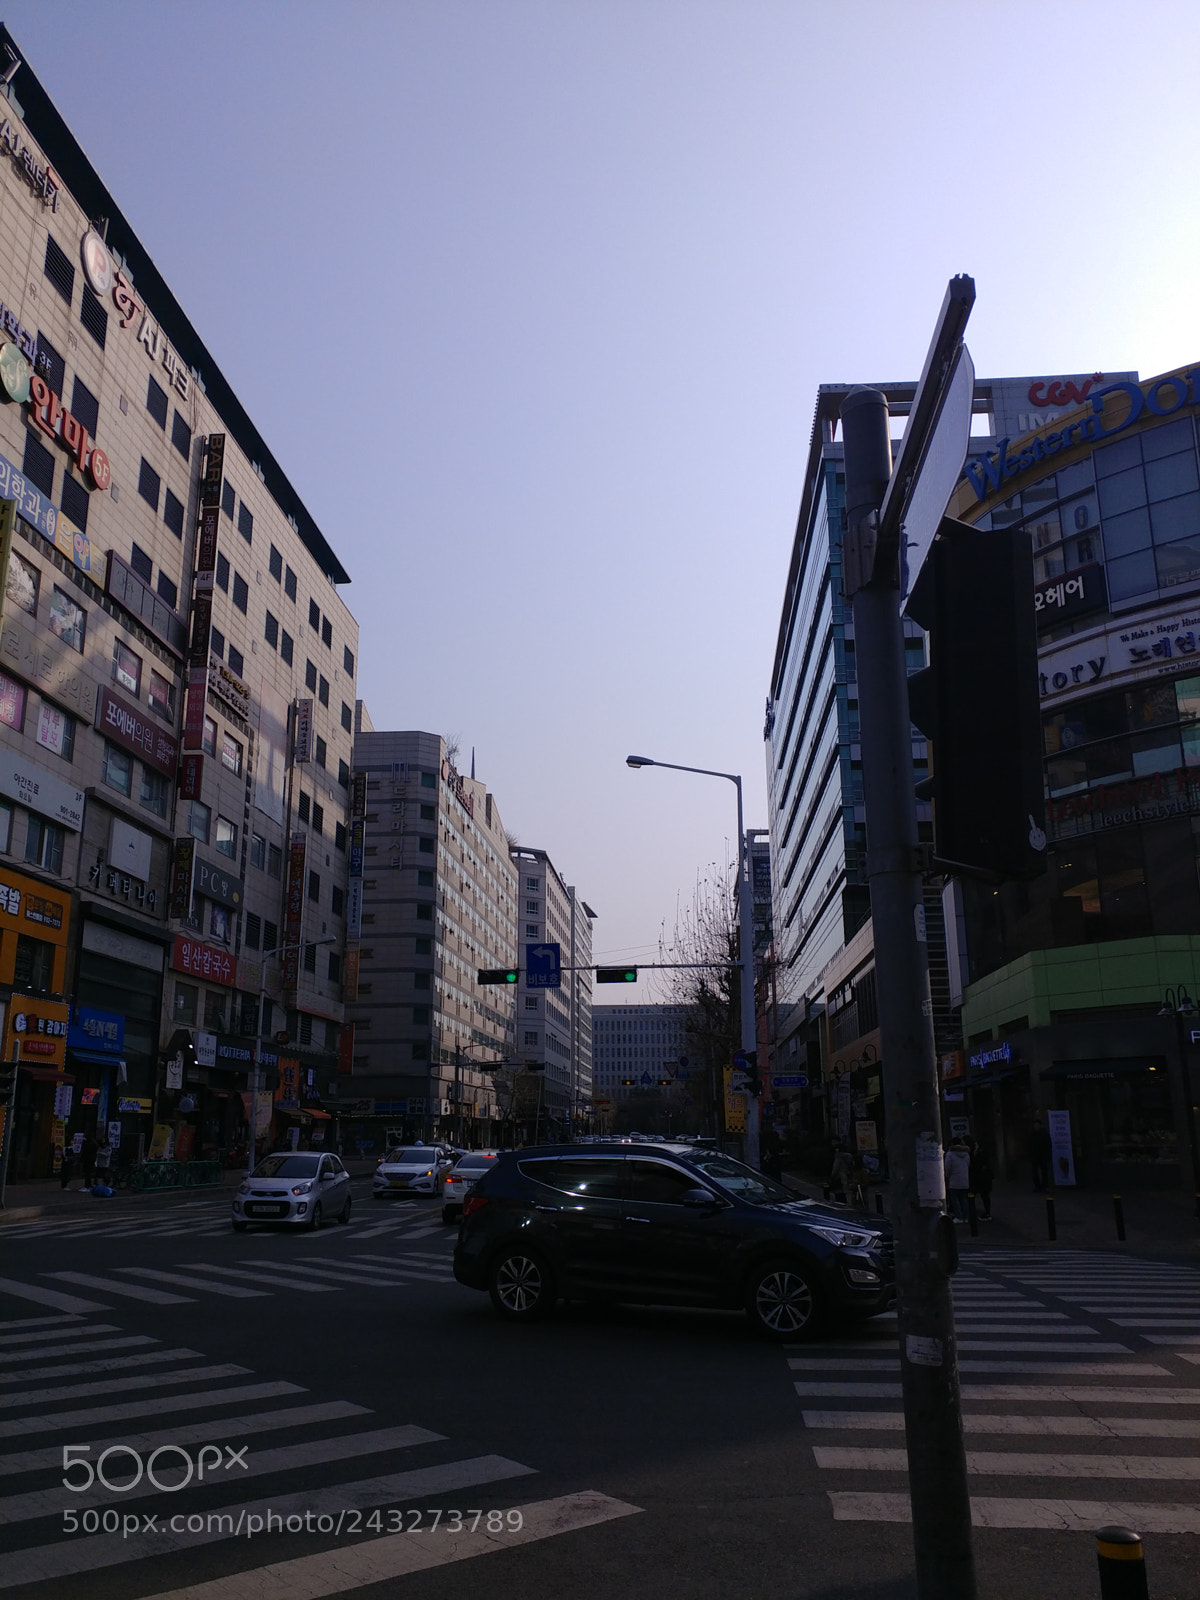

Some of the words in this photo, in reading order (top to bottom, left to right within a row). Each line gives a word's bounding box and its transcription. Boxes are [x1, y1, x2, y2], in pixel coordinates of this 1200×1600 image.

[1028, 379, 1092, 408] CGV
[95, 451, 110, 486] 5F
[207, 436, 223, 484] BAR
[963, 414, 1103, 503] Western
[1129, 631, 1200, 664] 노래연
[1131, 630, 1149, 641] Make
[1156, 623, 1180, 634] Happy
[1039, 656, 1106, 696] tory
[105, 700, 154, 755] 포에버의원
[14, 773, 40, 796] 야간진료
[182, 942, 231, 981] 일산칼국수
[528, 972, 560, 986] 비보호
[1085, 1072, 1115, 1080] BAGUETTE
